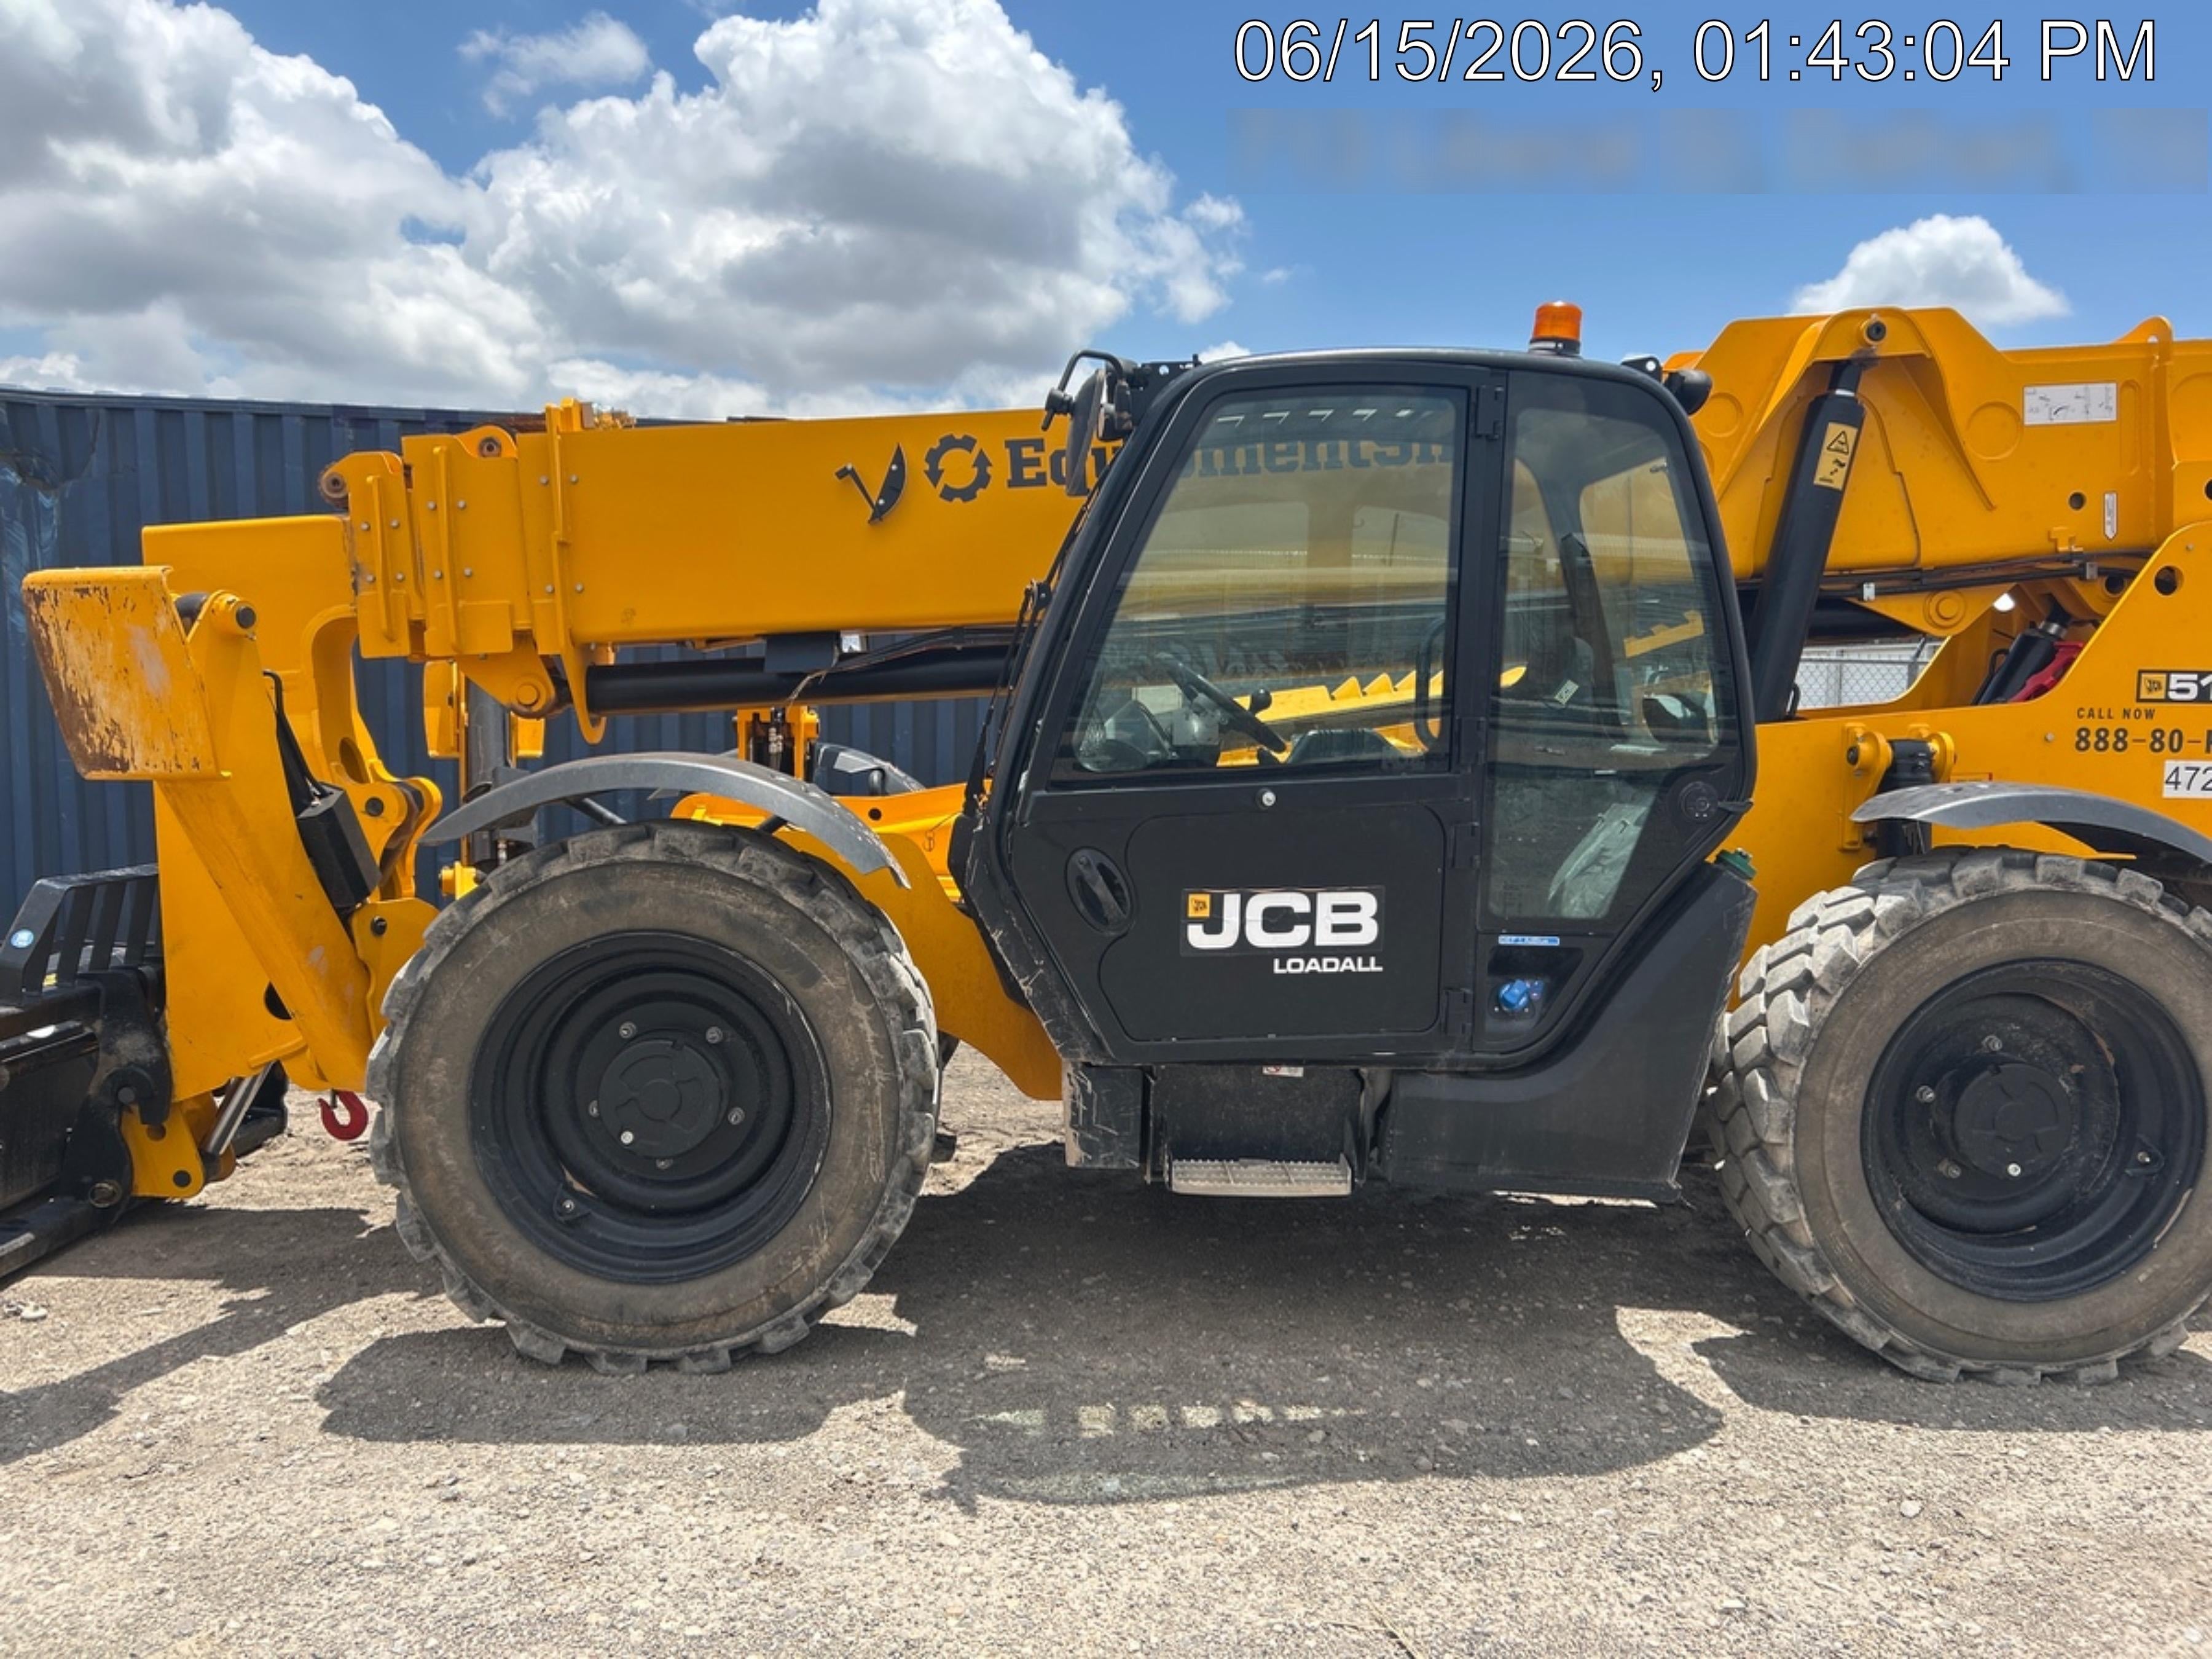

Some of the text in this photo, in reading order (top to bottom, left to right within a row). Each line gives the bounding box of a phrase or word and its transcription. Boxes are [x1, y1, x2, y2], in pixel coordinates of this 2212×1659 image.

[2077, 707, 2156, 720] CALL NOW
[1187, 892, 1378, 949] JCB
[1273, 957, 1383, 974] LOADALL
